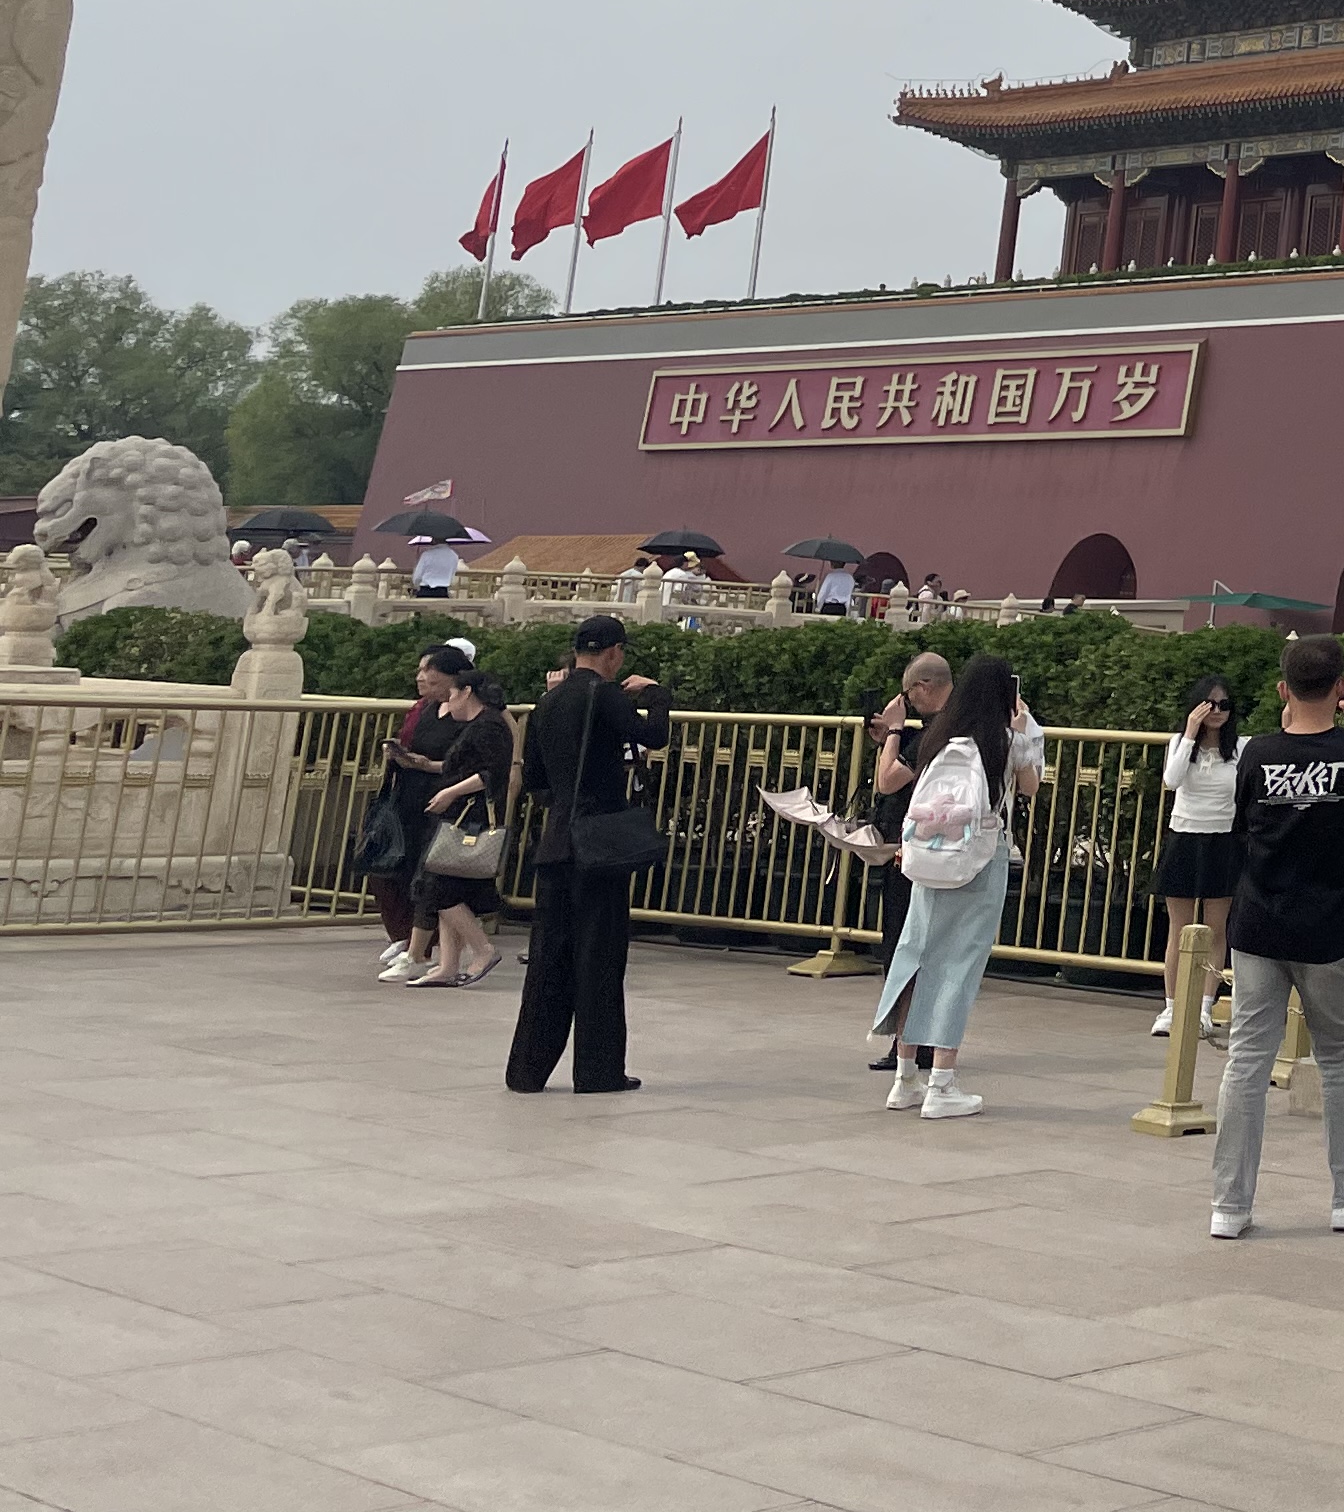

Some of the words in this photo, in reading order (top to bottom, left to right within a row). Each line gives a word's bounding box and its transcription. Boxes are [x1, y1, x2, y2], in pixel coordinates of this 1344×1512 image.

[669, 361, 1159, 436] 中华人民共和国万岁
